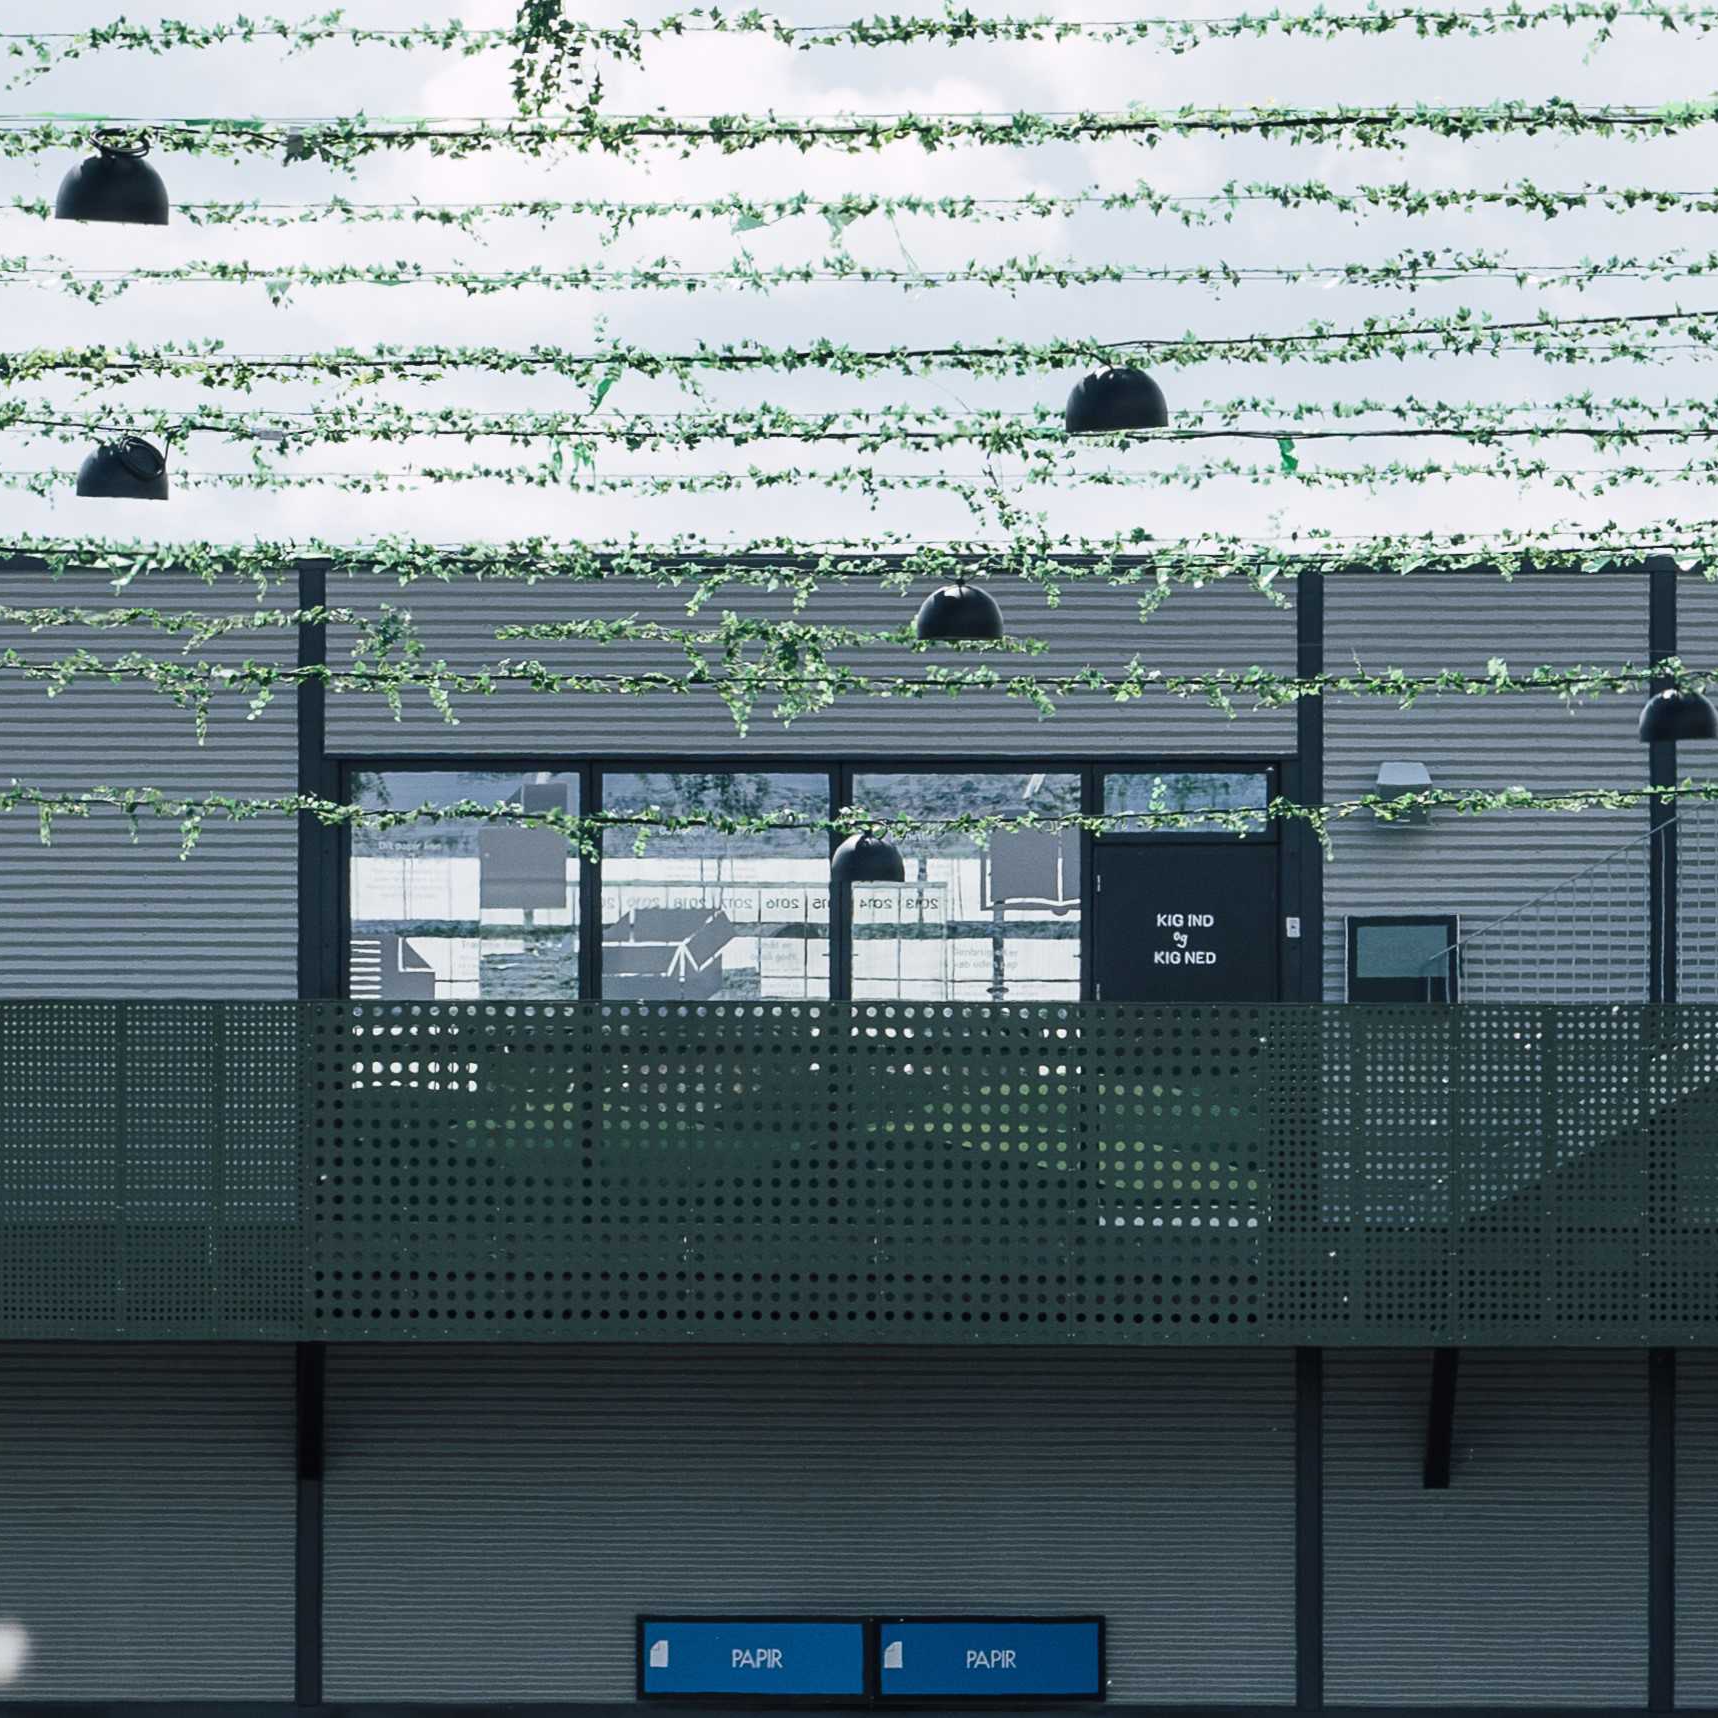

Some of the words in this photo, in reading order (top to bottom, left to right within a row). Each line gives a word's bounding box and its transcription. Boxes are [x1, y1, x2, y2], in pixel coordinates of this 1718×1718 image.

[1157, 913, 1184, 927] KIG
[1188, 913, 1214, 927] IND
[1173, 931, 1188, 948] og
[1154, 951, 1181, 964] KIG
[1184, 951, 1216, 964] NED
[731, 1648, 783, 1669] PAPIR
[966, 1650, 1017, 1669] PAPIR
